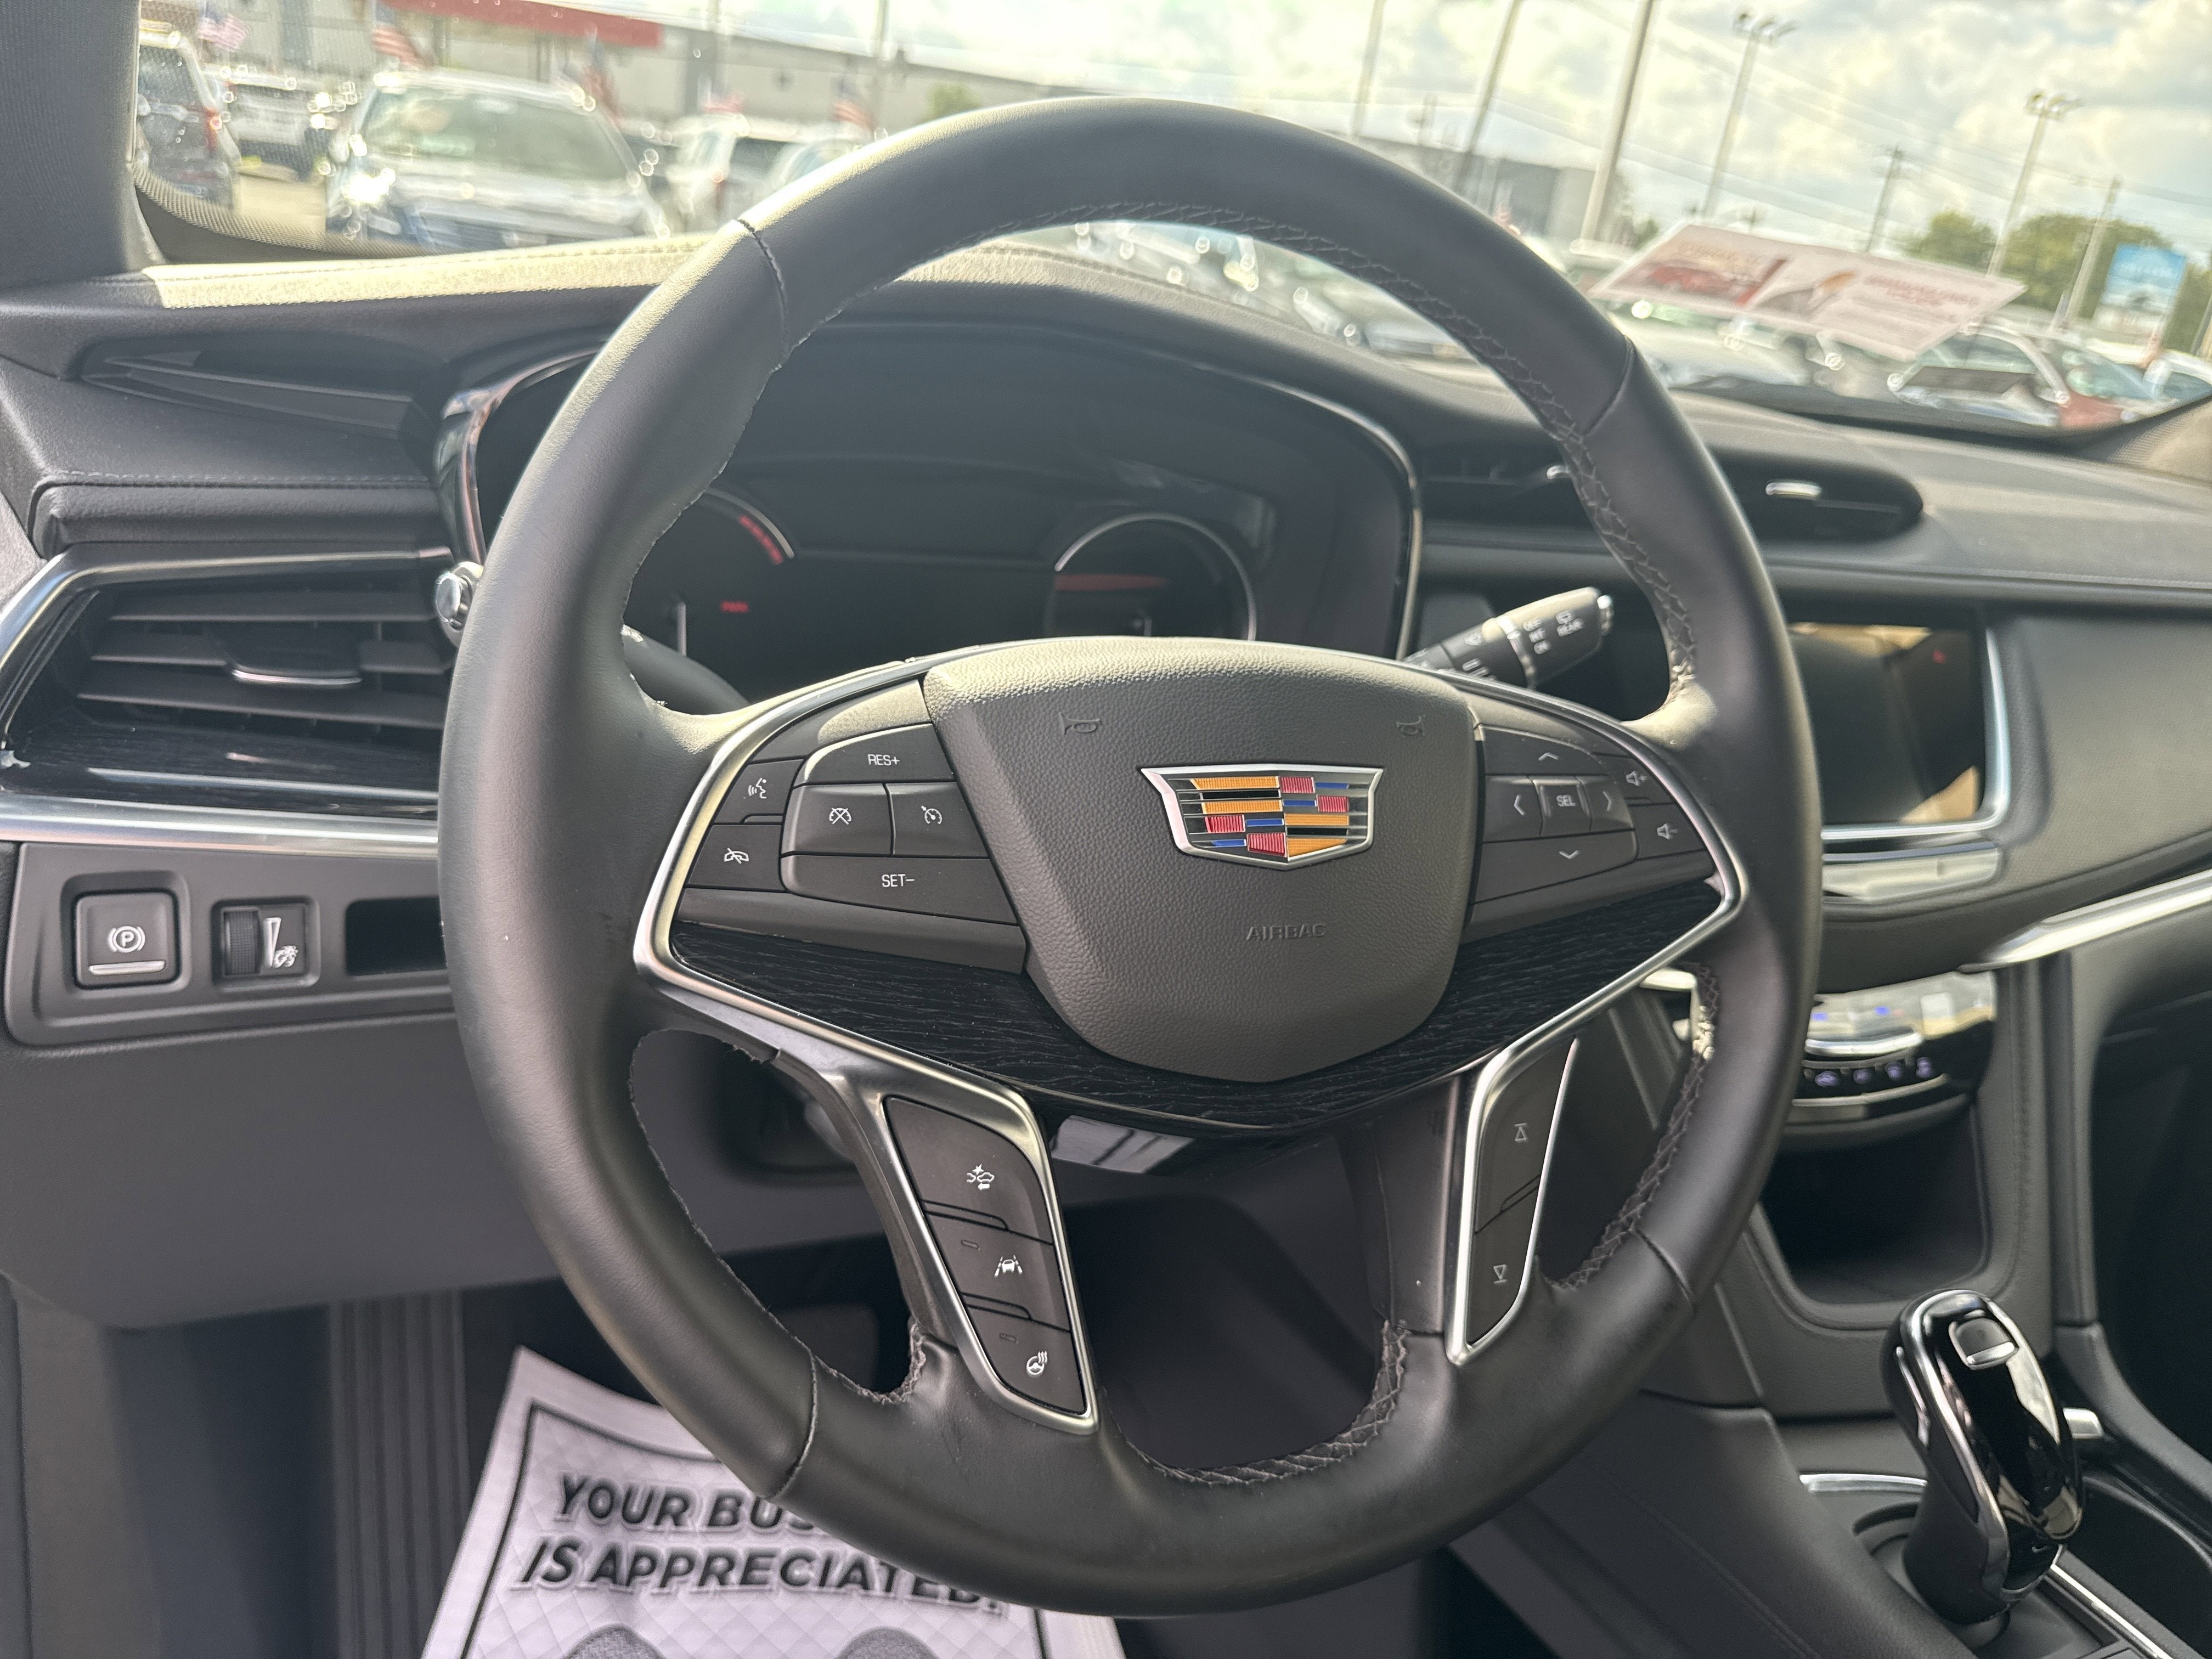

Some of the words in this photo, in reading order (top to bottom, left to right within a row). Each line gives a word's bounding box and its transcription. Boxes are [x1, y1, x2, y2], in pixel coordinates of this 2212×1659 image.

[867, 754, 900, 766] RES+
[882, 873, 915, 888] SET-
[1246, 923, 1327, 940] AIRBAG
[561, 1475, 692, 1527] YOUR
[521, 1538, 584, 1583] IS
